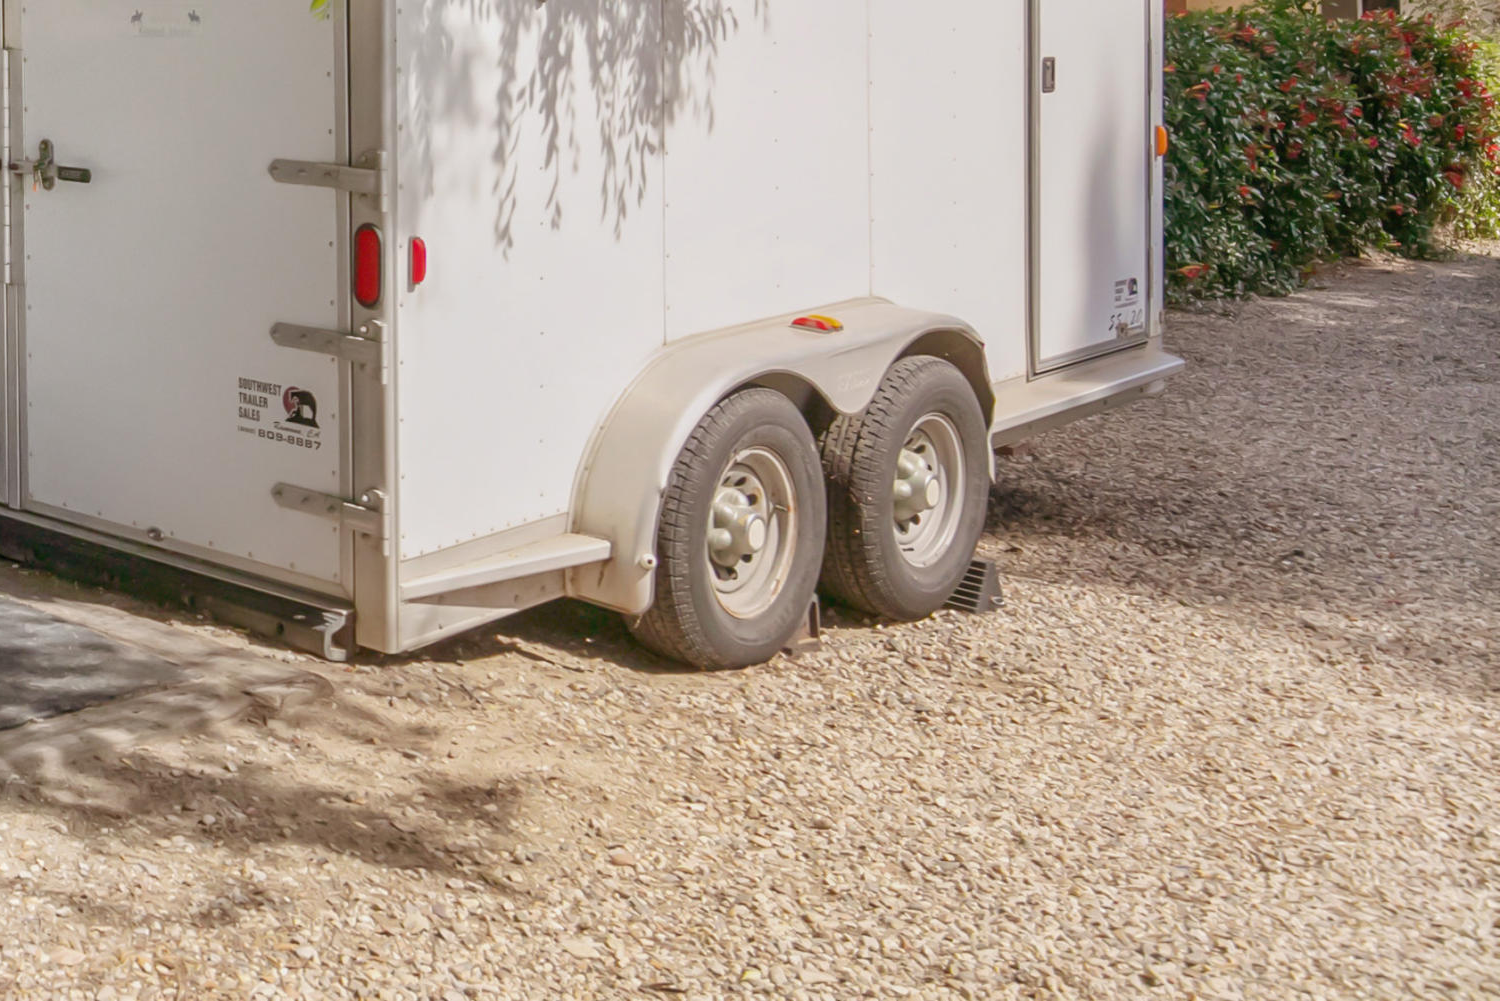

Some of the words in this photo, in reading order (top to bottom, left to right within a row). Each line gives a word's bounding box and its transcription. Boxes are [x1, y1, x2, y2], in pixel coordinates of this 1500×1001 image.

[238, 377, 281, 396] SOUTHWEST
[238, 392, 268, 408] TRAILER
[238, 406, 260, 422] SALES
